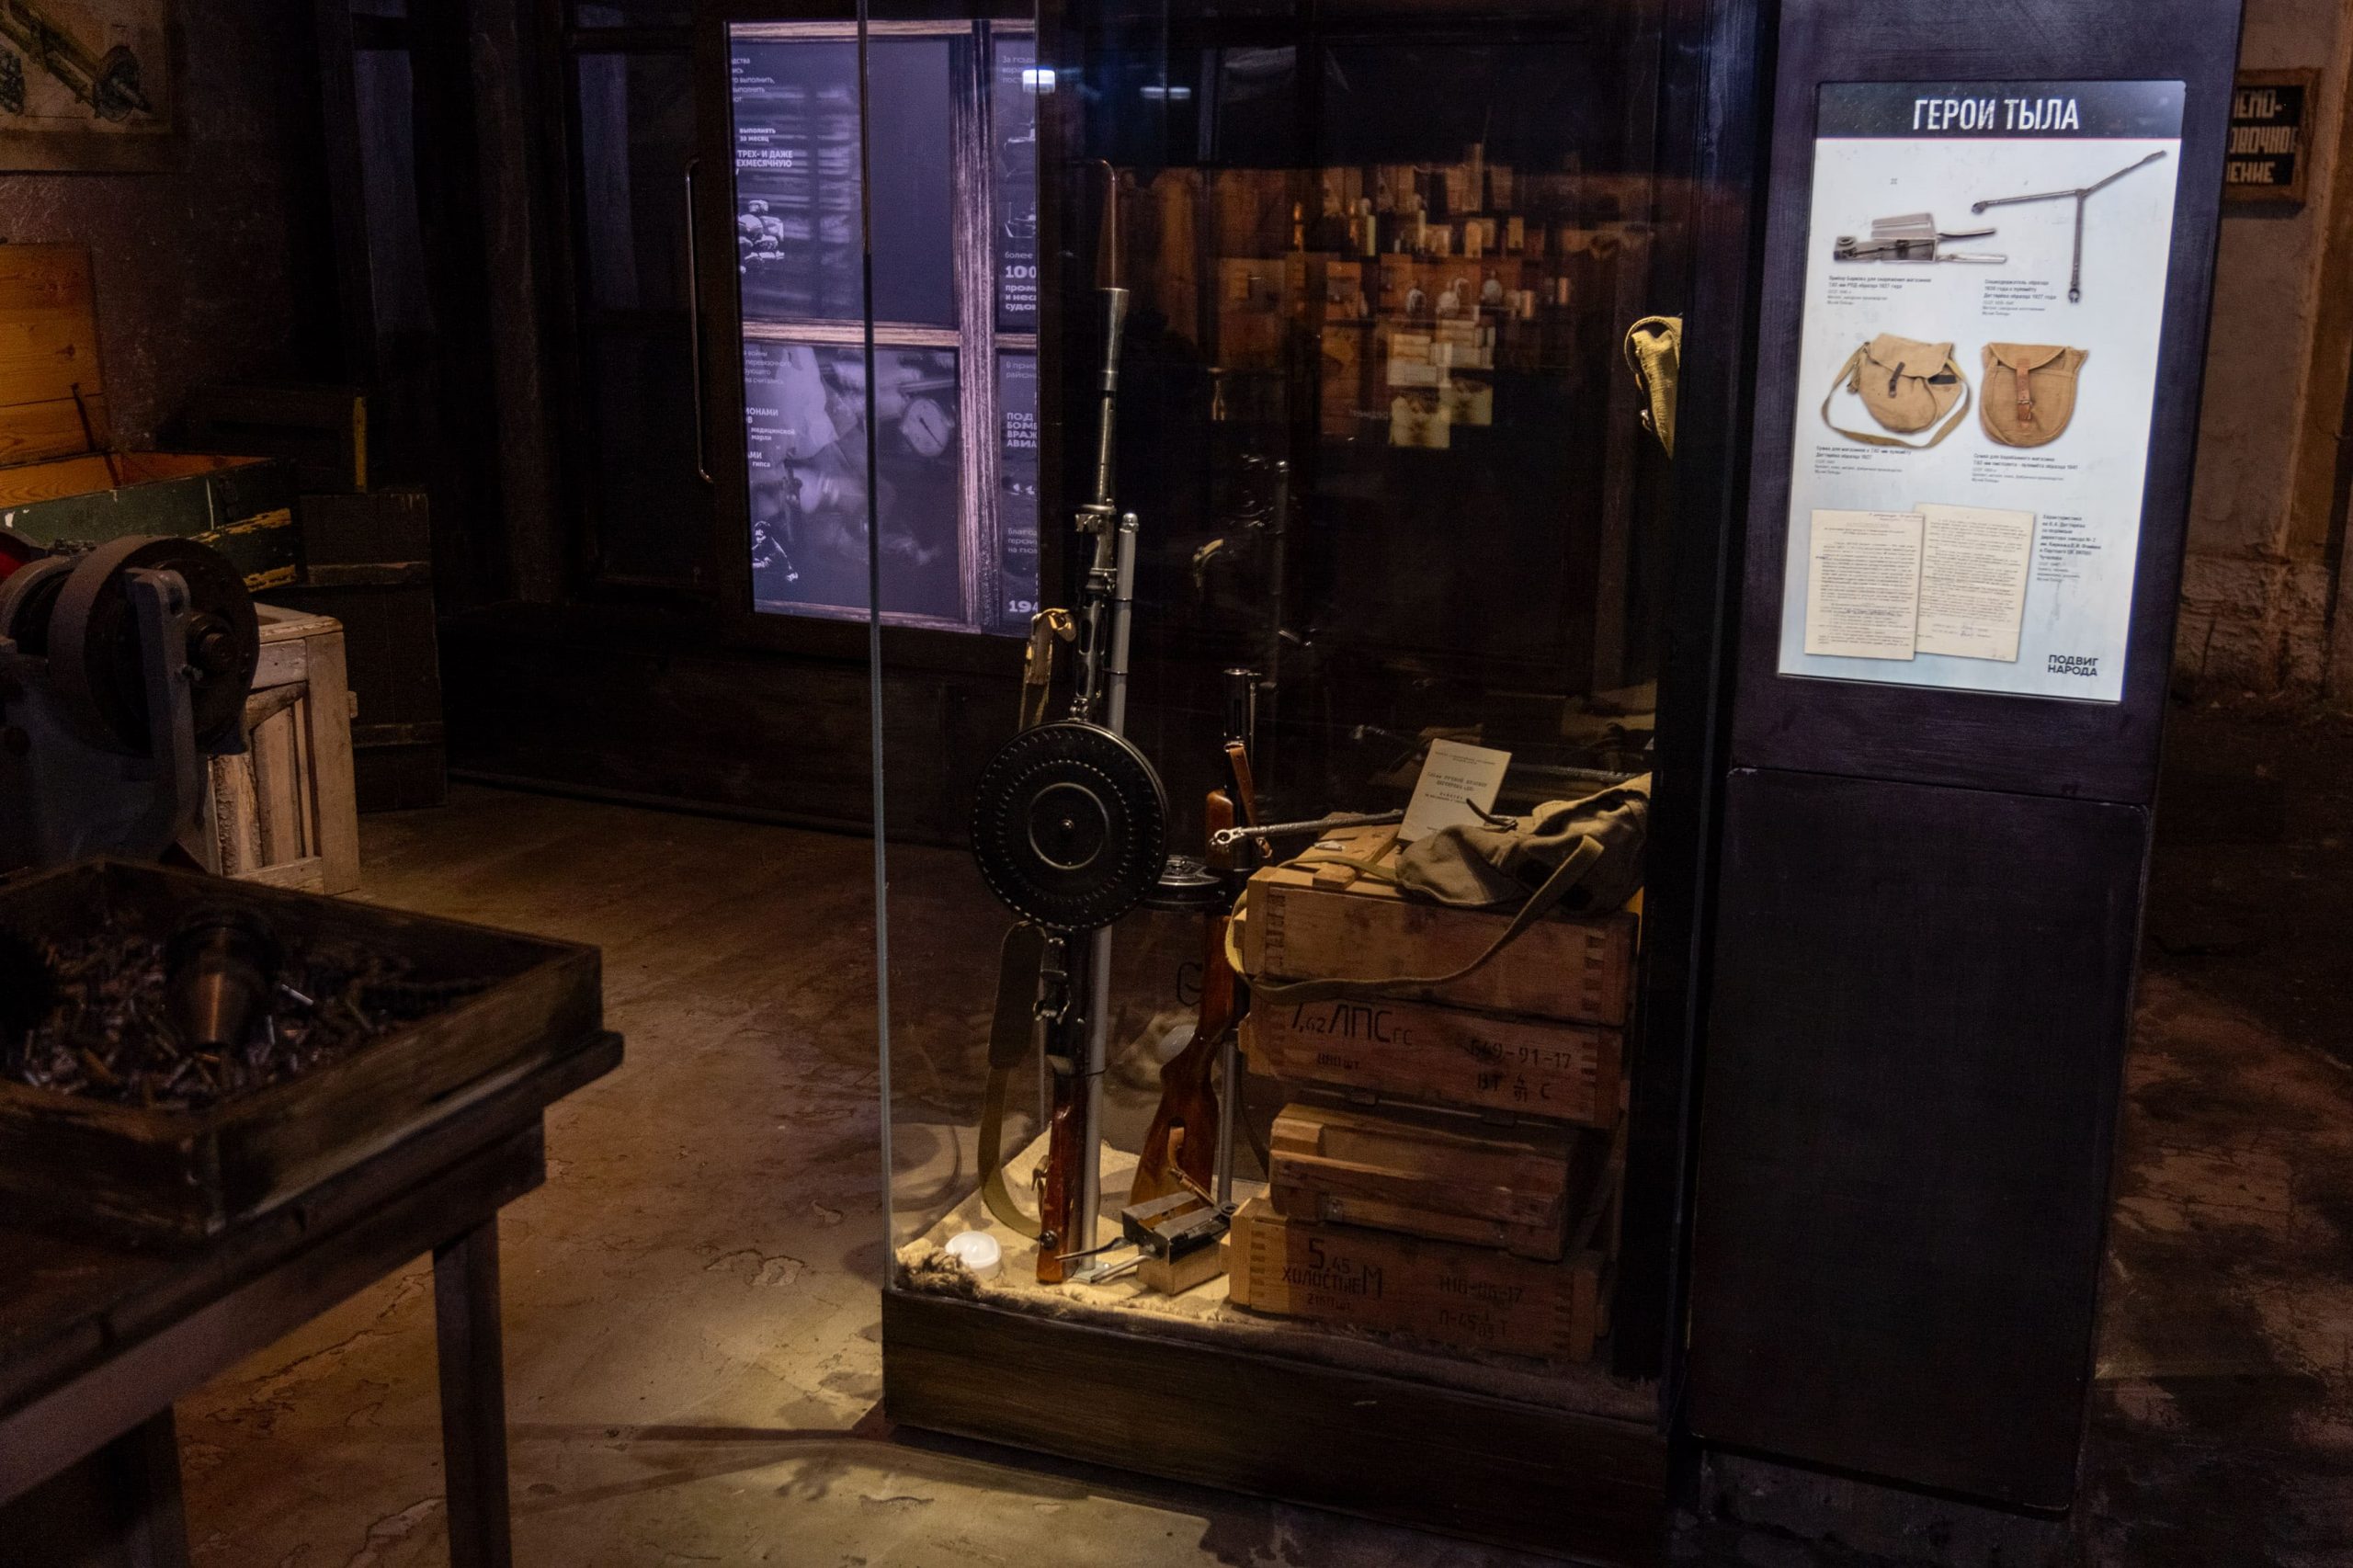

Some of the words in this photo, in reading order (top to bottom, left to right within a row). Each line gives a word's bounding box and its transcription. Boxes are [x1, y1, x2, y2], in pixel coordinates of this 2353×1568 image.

[1913, 98, 1995, 131] ГЕРОИ
[2006, 98, 2079, 131] ТЫЛА
[761, 150, 767, 158] И
[769, 150, 793, 159] ДАЖЕ
[1007, 412, 1033, 421] ПОД
[2049, 654, 2099, 666] ПОДВИГ
[2047, 664, 2097, 676] НАРОДА
